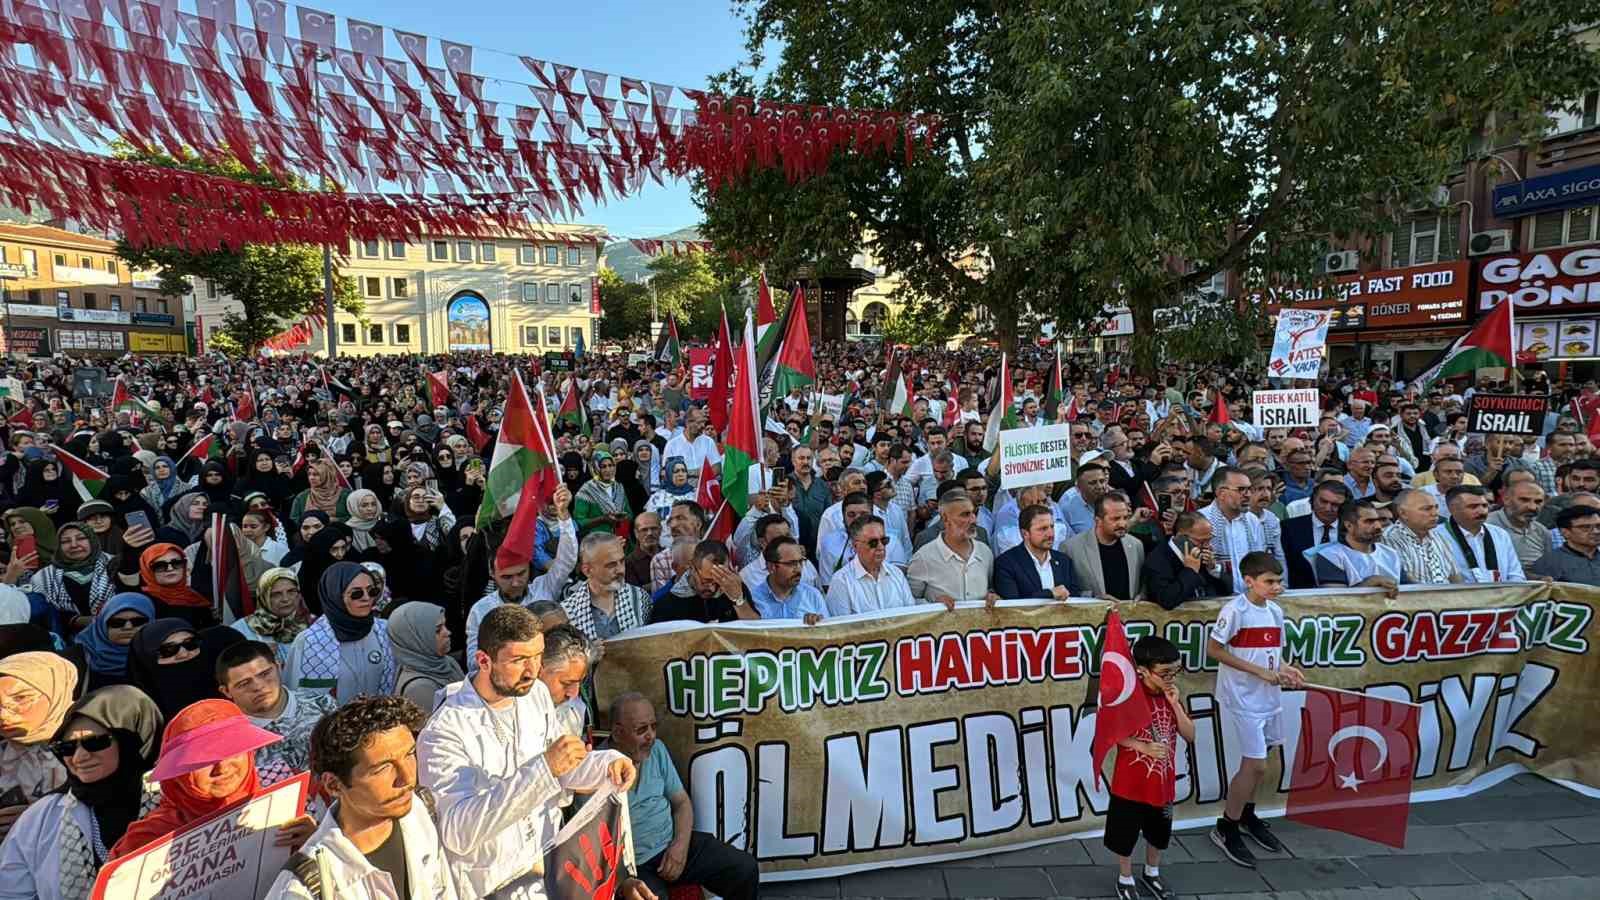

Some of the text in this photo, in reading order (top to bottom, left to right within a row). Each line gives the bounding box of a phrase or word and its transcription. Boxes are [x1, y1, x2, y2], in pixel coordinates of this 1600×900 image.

[1523, 187, 1556, 202] AXA
[1367, 275, 1404, 294] FAST
[1412, 270, 1453, 289] FOOD
[1371, 302, 1410, 316] DÖNER
[1256, 390, 1316, 405] BEBEK KATİLİ
[1474, 396, 1545, 410] SOYKIRIMCI
[1260, 404, 1312, 426] İSRAİL
[1476, 410, 1533, 433] İSRAİL
[1004, 439, 1068, 457] FİLİSTİNE DESTEK
[1004, 456, 1068, 475] SİYONİZME LANET
[160, 845, 238, 896] KANA
